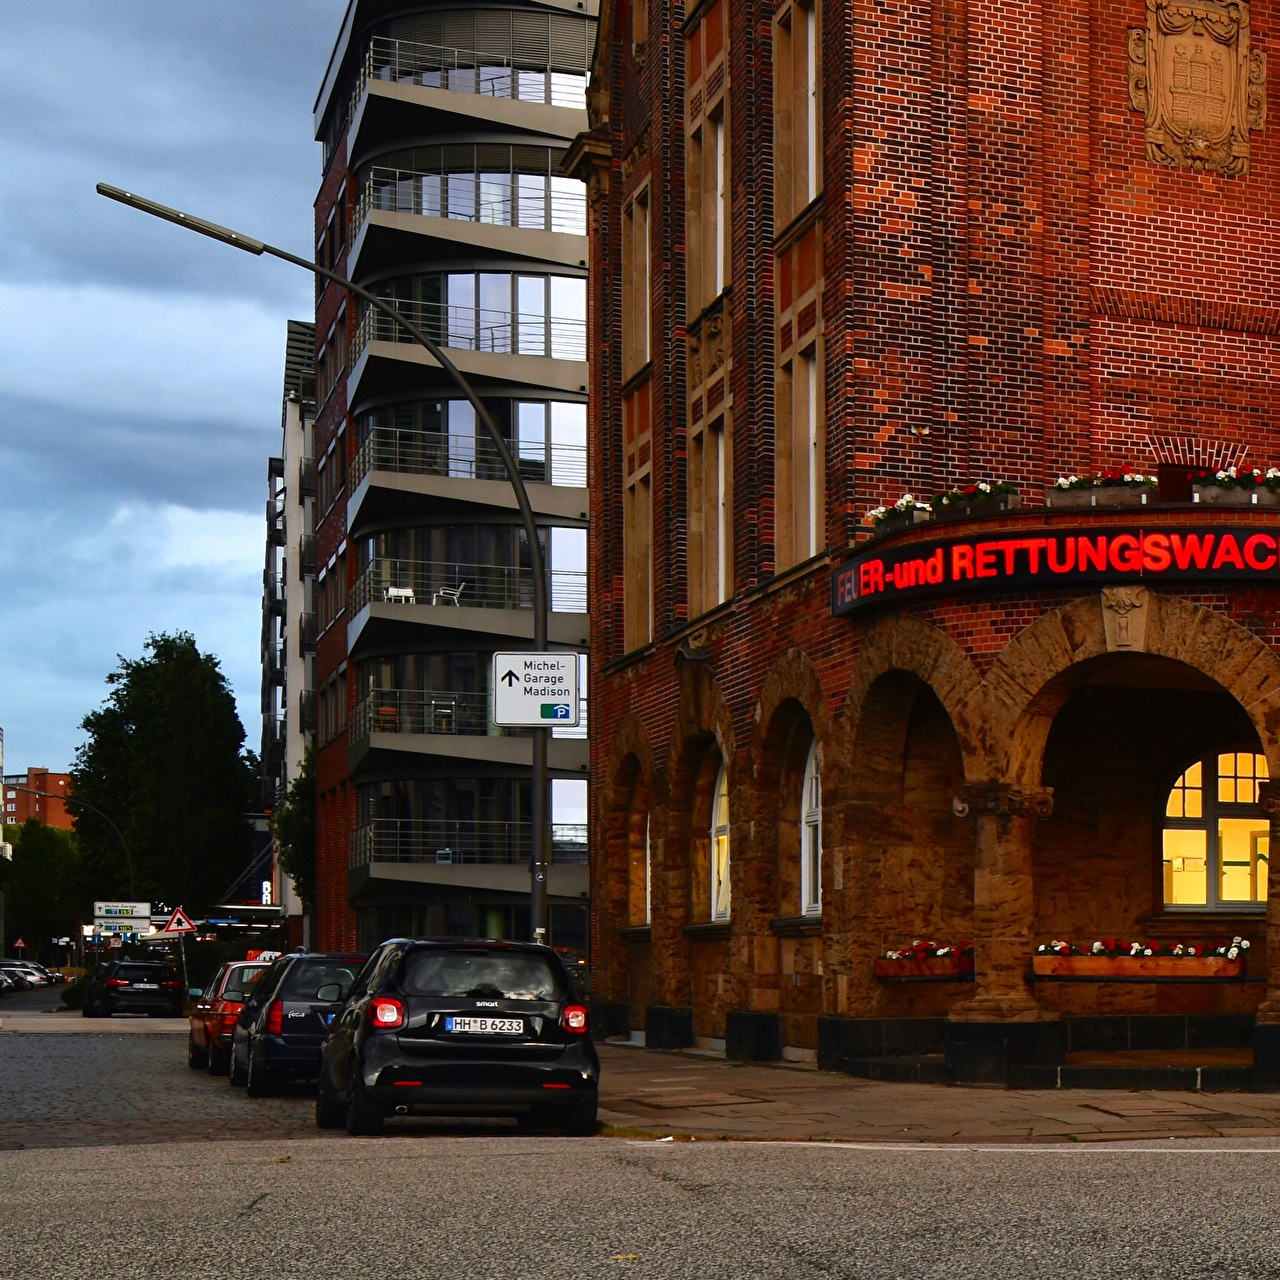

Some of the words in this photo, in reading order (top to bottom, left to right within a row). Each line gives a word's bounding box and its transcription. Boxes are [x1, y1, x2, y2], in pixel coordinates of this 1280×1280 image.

[523, 661, 565, 671] Michel-
[523, 674, 564, 685] Garage
[523, 686, 570, 696] Madison
[557, 708, 566, 718] P
